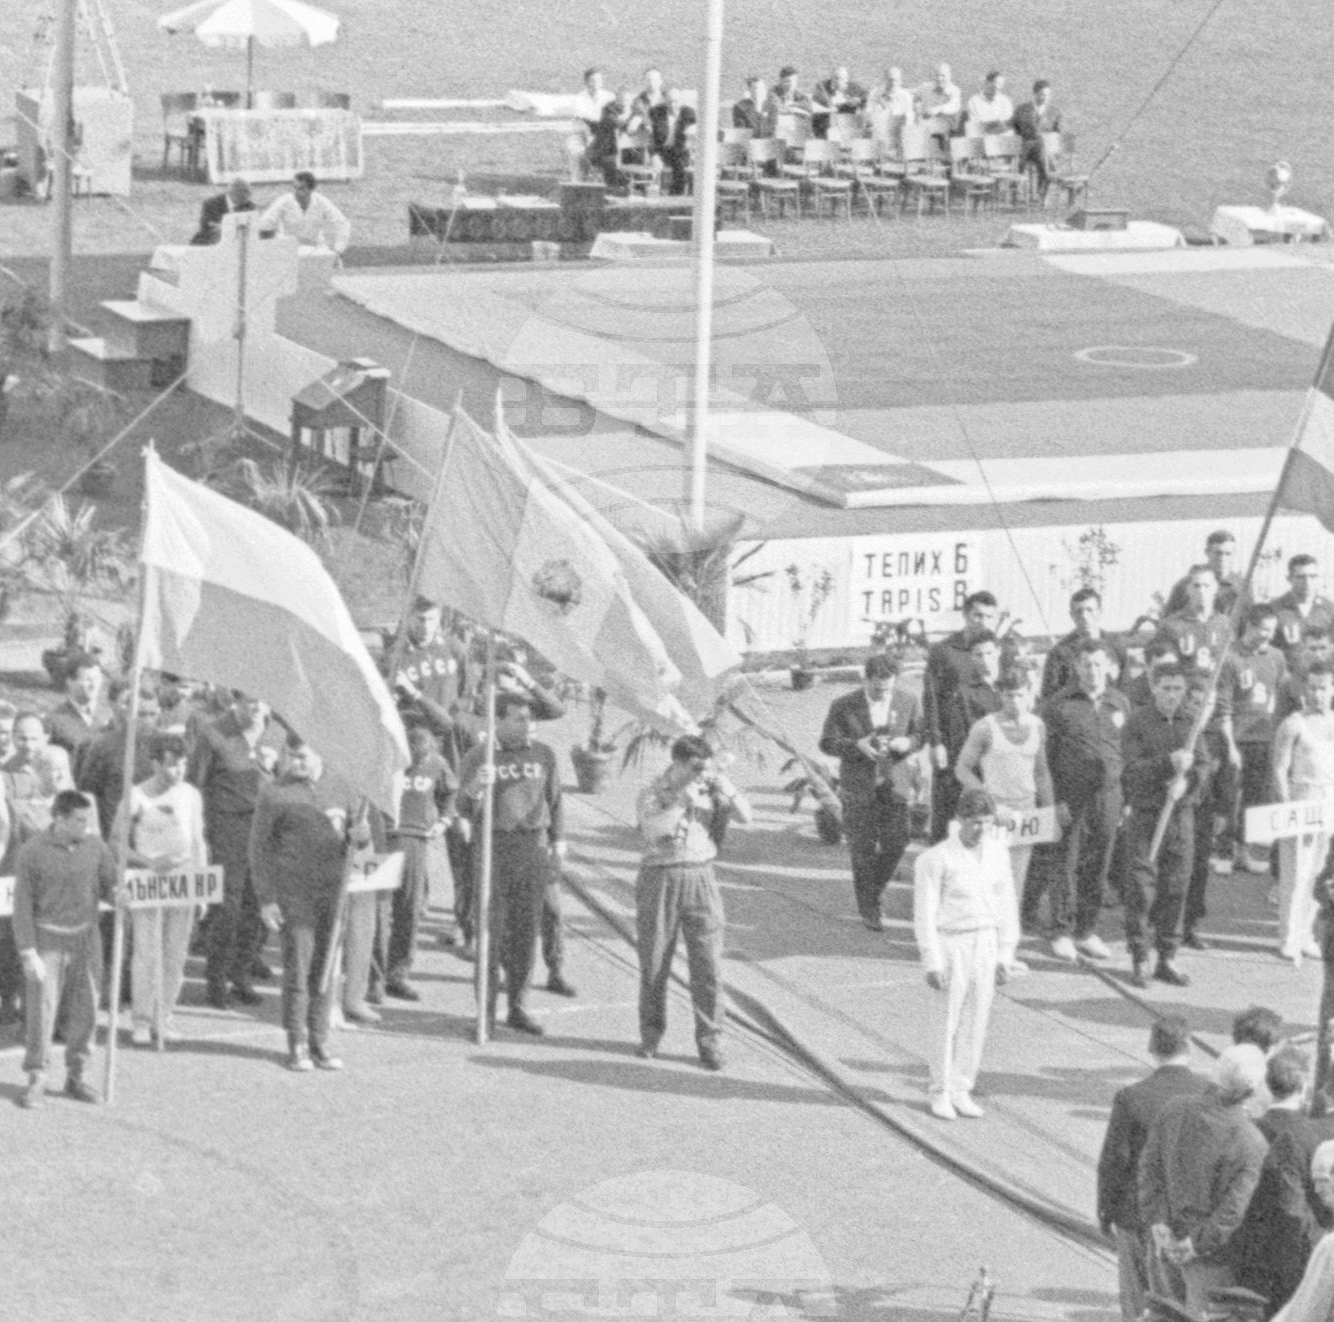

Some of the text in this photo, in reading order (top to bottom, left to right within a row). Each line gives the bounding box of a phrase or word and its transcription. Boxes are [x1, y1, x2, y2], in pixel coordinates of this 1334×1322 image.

[863, 543, 968, 578] ТЕПИХ Б
[862, 588, 941, 614] TAPIS
[1270, 805, 1324, 832] САЩ
[194, 873, 218, 898] НР
